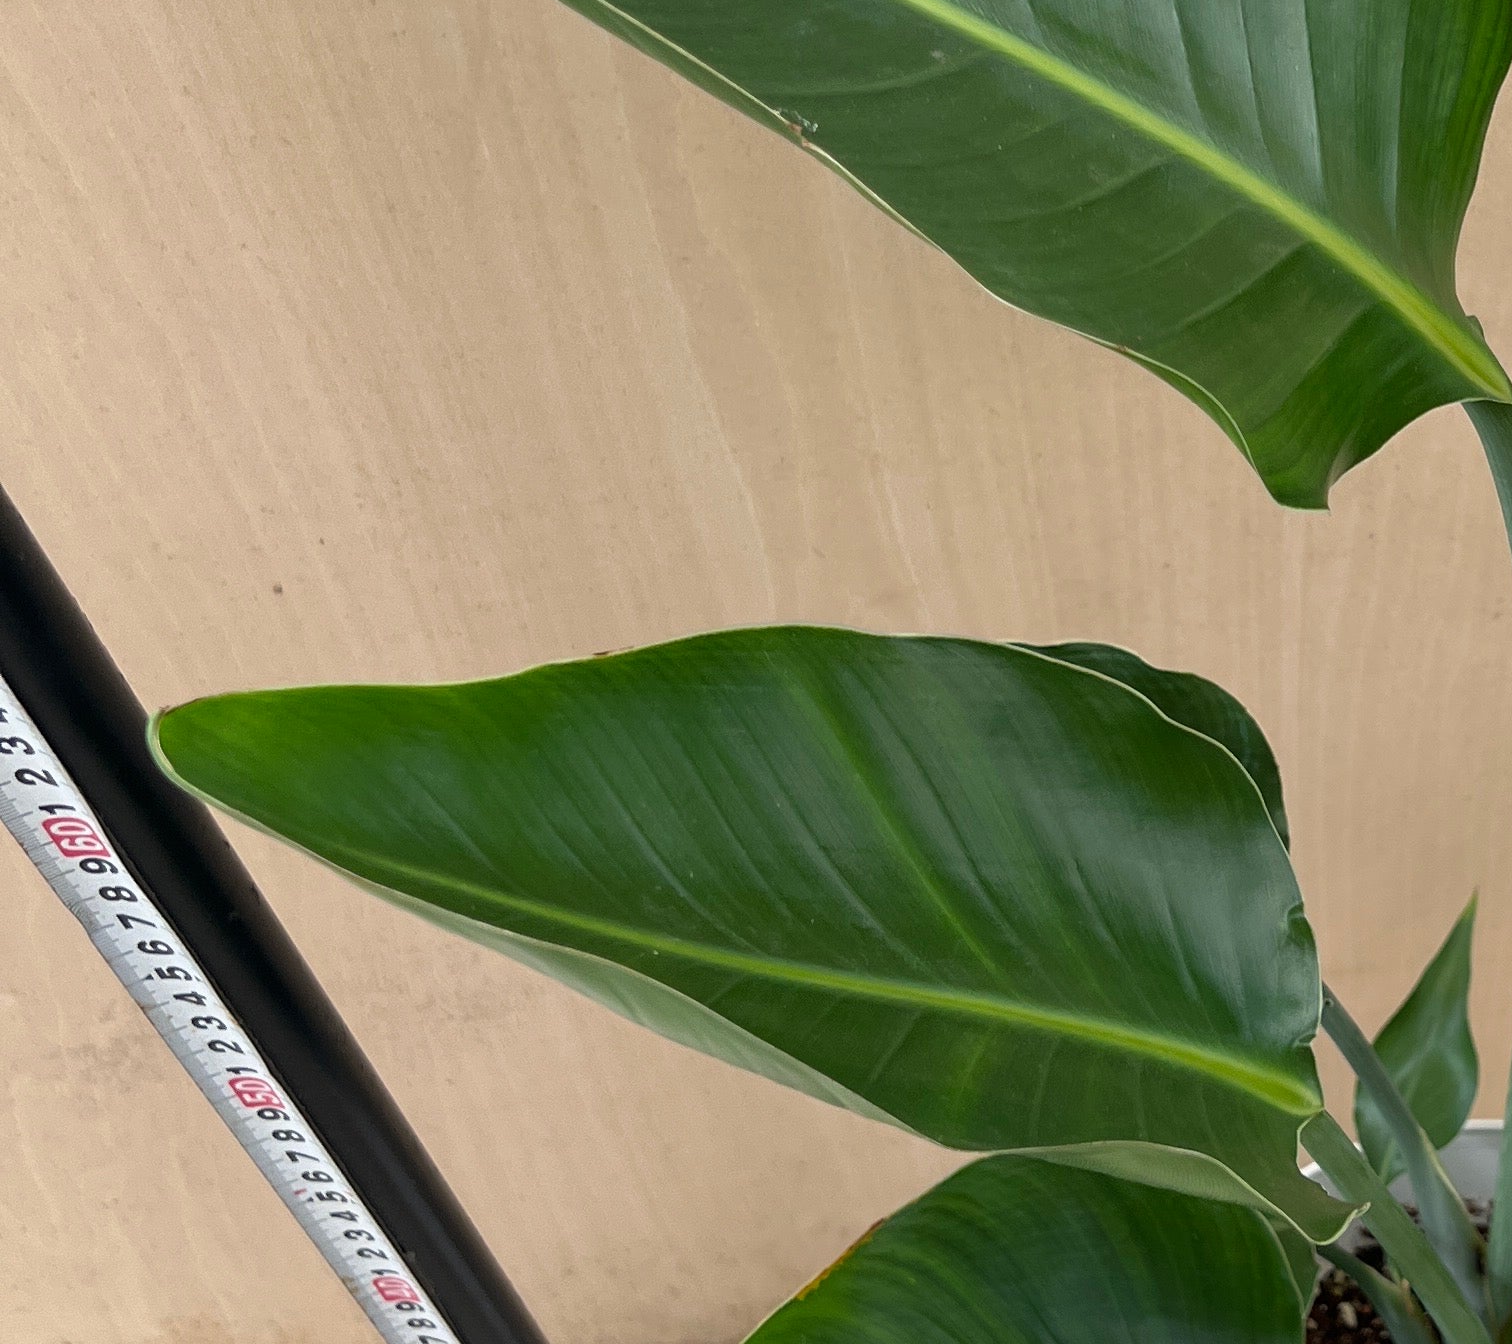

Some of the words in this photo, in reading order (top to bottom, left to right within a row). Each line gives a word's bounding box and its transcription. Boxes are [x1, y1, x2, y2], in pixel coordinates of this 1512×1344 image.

[0, 736, 36, 755] 3
[15, 768, 59, 787] 2
[38, 804, 76, 814] 1
[50, 821, 102, 851] 60
[79, 857, 118, 874] 9
[99, 886, 137, 902] 8
[117, 913, 157, 929] 7
[138, 940, 174, 954] 6
[154, 966, 192, 981] 5
[173, 991, 206, 1006] 4
[192, 1016, 227, 1030] 3
[208, 1039, 244, 1054] 2
[232, 1079, 281, 1105] 50
[257, 1108, 290, 1121] 9
[272, 1130, 305, 1142] 8
[286, 1150, 320, 1163] 7
[302, 1171, 334, 1182] 6
[316, 1191, 348, 1202] 5
[330, 1210, 358, 1221] 4
[344, 1229, 375, 1241] 3
[357, 1247, 389, 1259] 2
